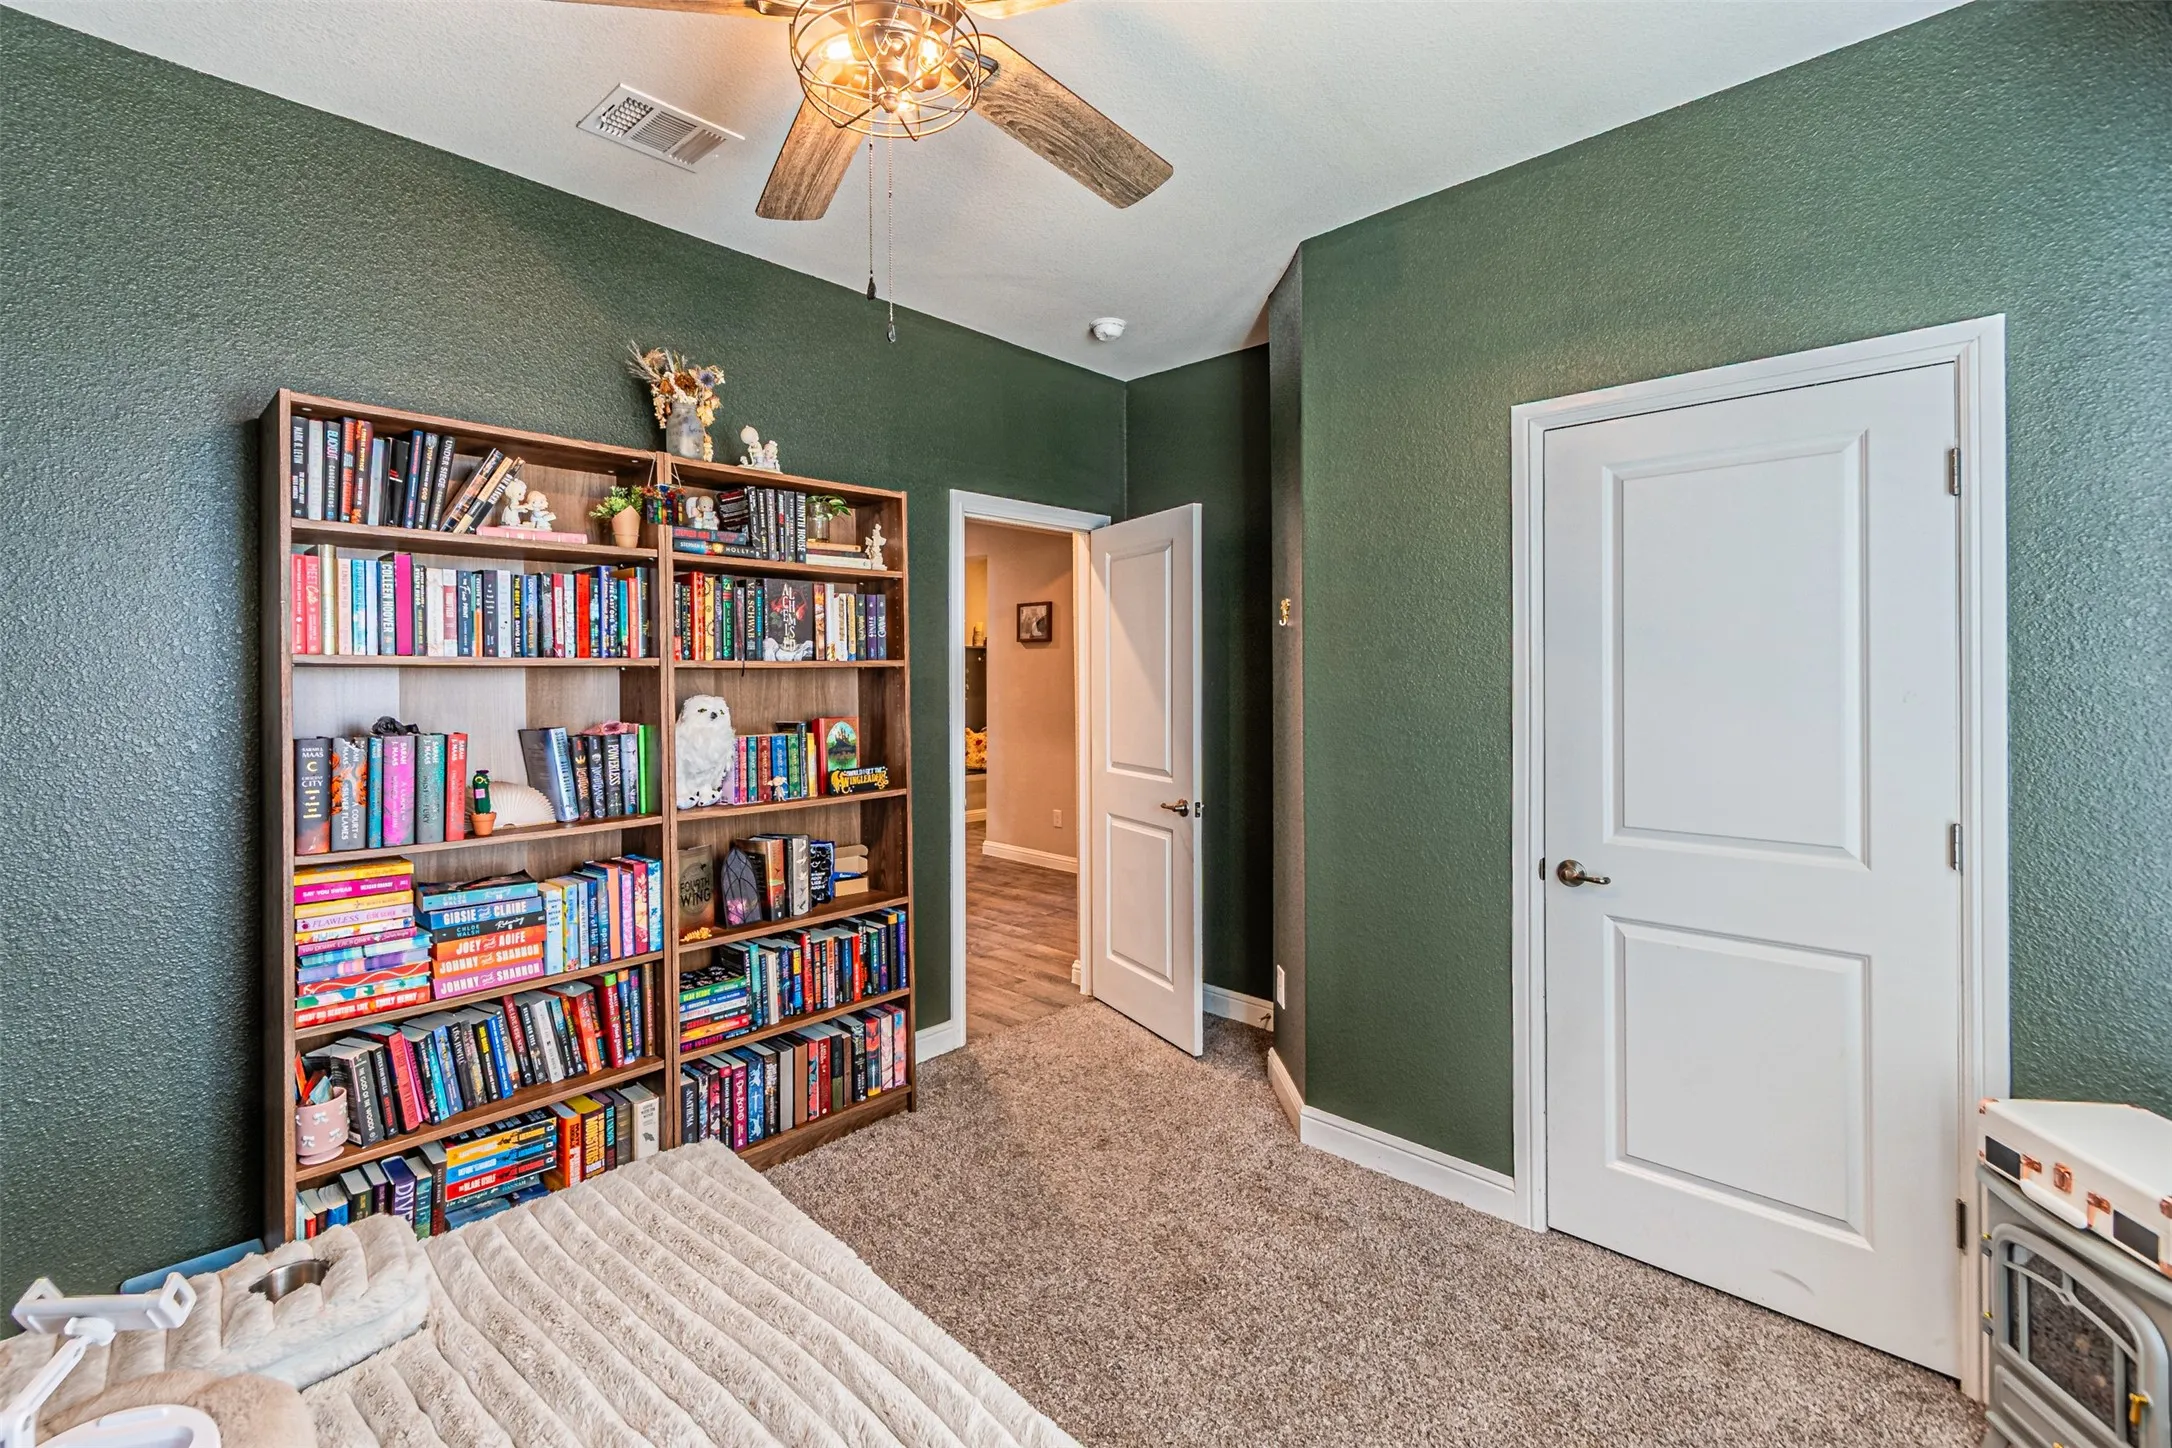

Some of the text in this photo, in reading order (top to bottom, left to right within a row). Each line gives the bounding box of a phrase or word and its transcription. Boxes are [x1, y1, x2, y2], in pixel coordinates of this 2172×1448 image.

[294, 426, 303, 441] MARK
[294, 449, 304, 465] LEVIN
[327, 430, 338, 461] BLACKOUT
[438, 440, 453, 488] UNDER SIEGE
[328, 465, 336, 489] CANDACE
[797, 505, 806, 552] NINTH HOUSE
[306, 564, 318, 584] MEET
[381, 564, 394, 632] COLLEEN HOOVER
[748, 590, 755, 598] E.
[400, 743, 408, 765] SARAH
[424, 746, 432, 765] MAAS
[607, 744, 620, 786] POWERLESS
[301, 780, 324, 788] CITY
[590, 764, 604, 805] NIGHTBANE
[341, 787, 349, 840] SILVER FLAMES
[351, 809, 359, 832] COURT
[680, 878, 710, 893] FOURTH
[590, 898, 598, 917] family
[681, 889, 711, 907] WING
[312, 915, 359, 929] FLAWLESS
[443, 901, 527, 926] GIBSIE CLAIRE
[591, 920, 598, 928] of
[600, 897, 609, 950] we fell apart
[456, 925, 480, 933] CHLOE
[457, 929, 480, 937] WALSH
[456, 931, 526, 955] JOEY AOIFE
[439, 943, 541, 975] JOHNNY SHANNON
[440, 962, 541, 995] JOHNNY SHANNON
[397, 992, 416, 1003] HENRY
[497, 1015, 510, 1052] Those Girls
[528, 1036, 536, 1046] EYES
[452, 1027, 466, 1065] LISA JEWELL
[361, 1076, 369, 1090] GOD
[365, 1108, 374, 1131] WOODS
[686, 1090, 695, 1128] ANATHEMA
[585, 1115, 599, 1164] MONSTERS
[463, 1178, 481, 1192] BLADE
